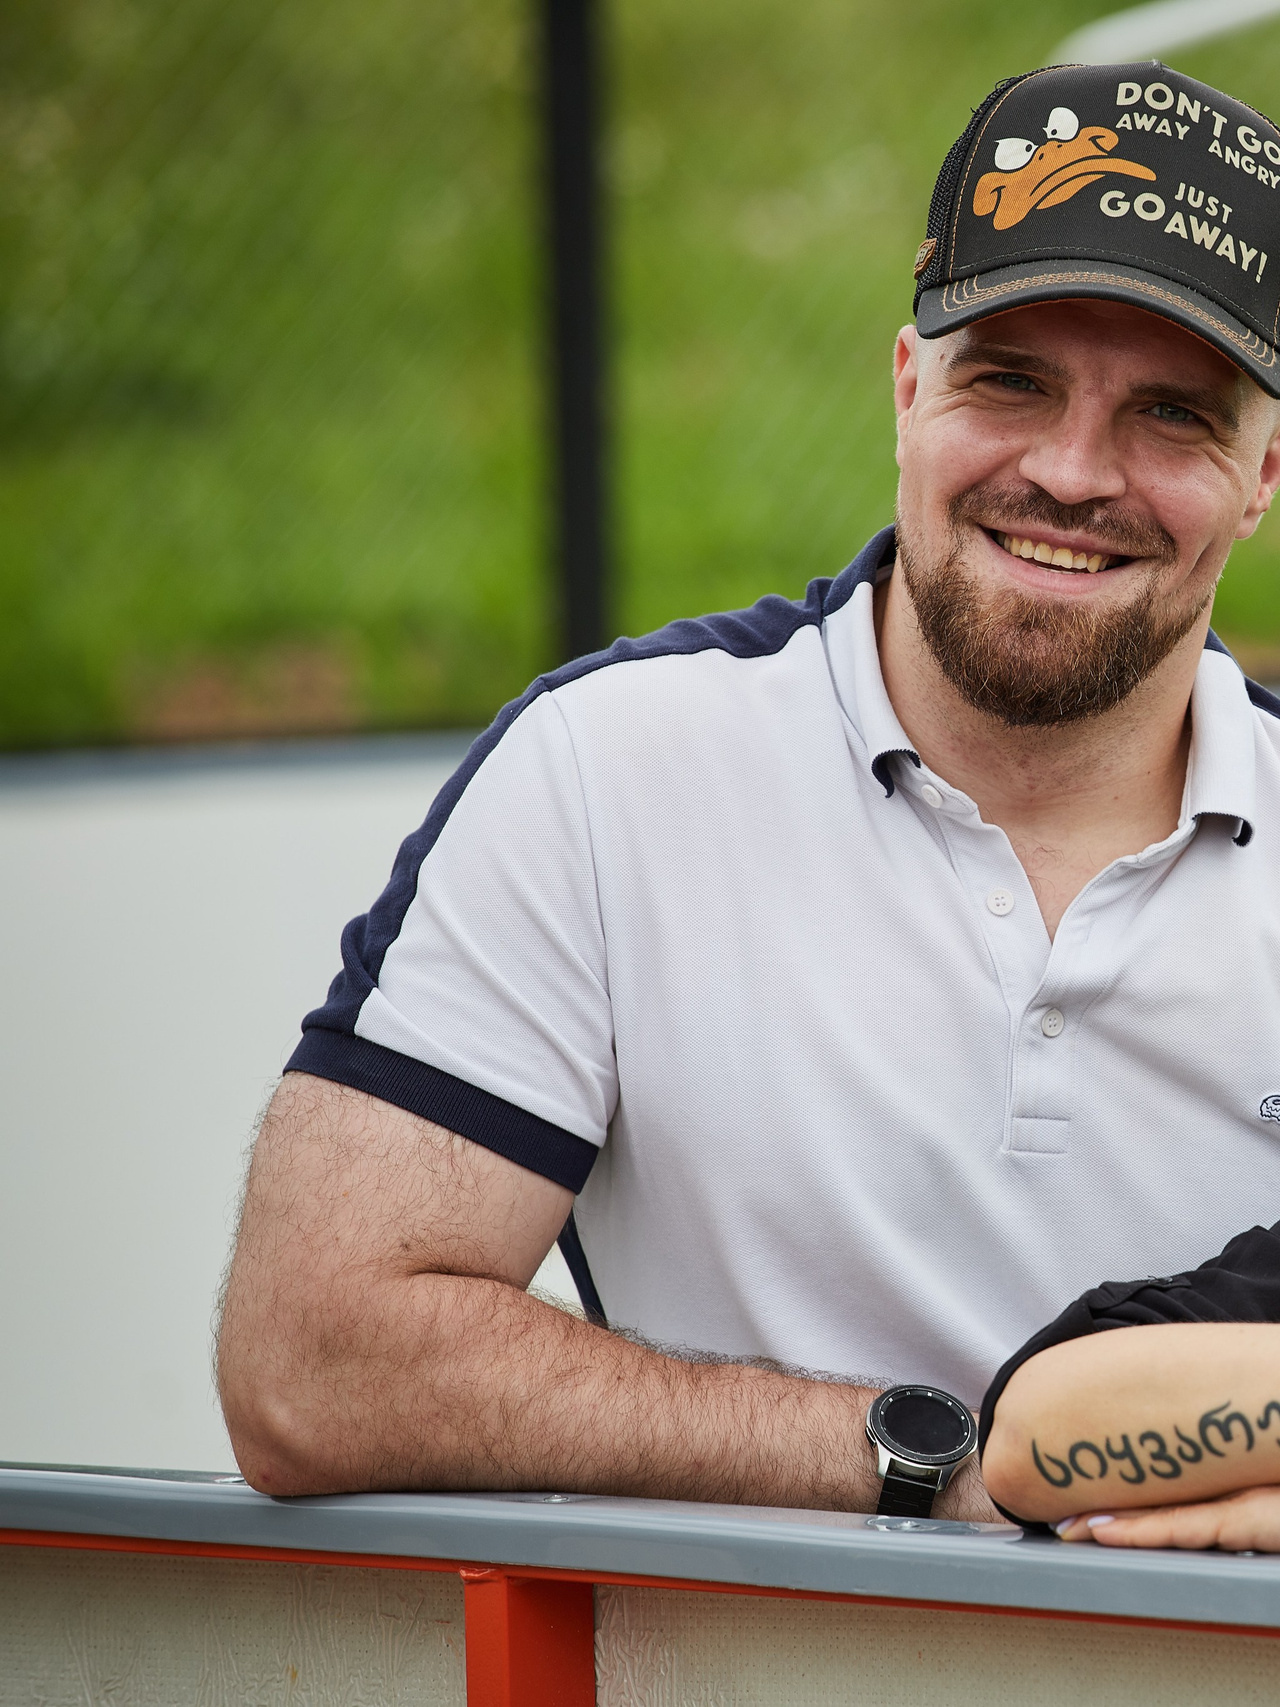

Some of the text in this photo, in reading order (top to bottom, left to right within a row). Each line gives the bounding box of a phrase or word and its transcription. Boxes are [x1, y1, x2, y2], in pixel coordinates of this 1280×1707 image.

[1115, 112, 1191, 141] AWAY
[1116, 81, 1228, 138] DON'T
[1174, 182, 1234, 225] JUST
[1099, 190, 1268, 284] GO AWAY!
